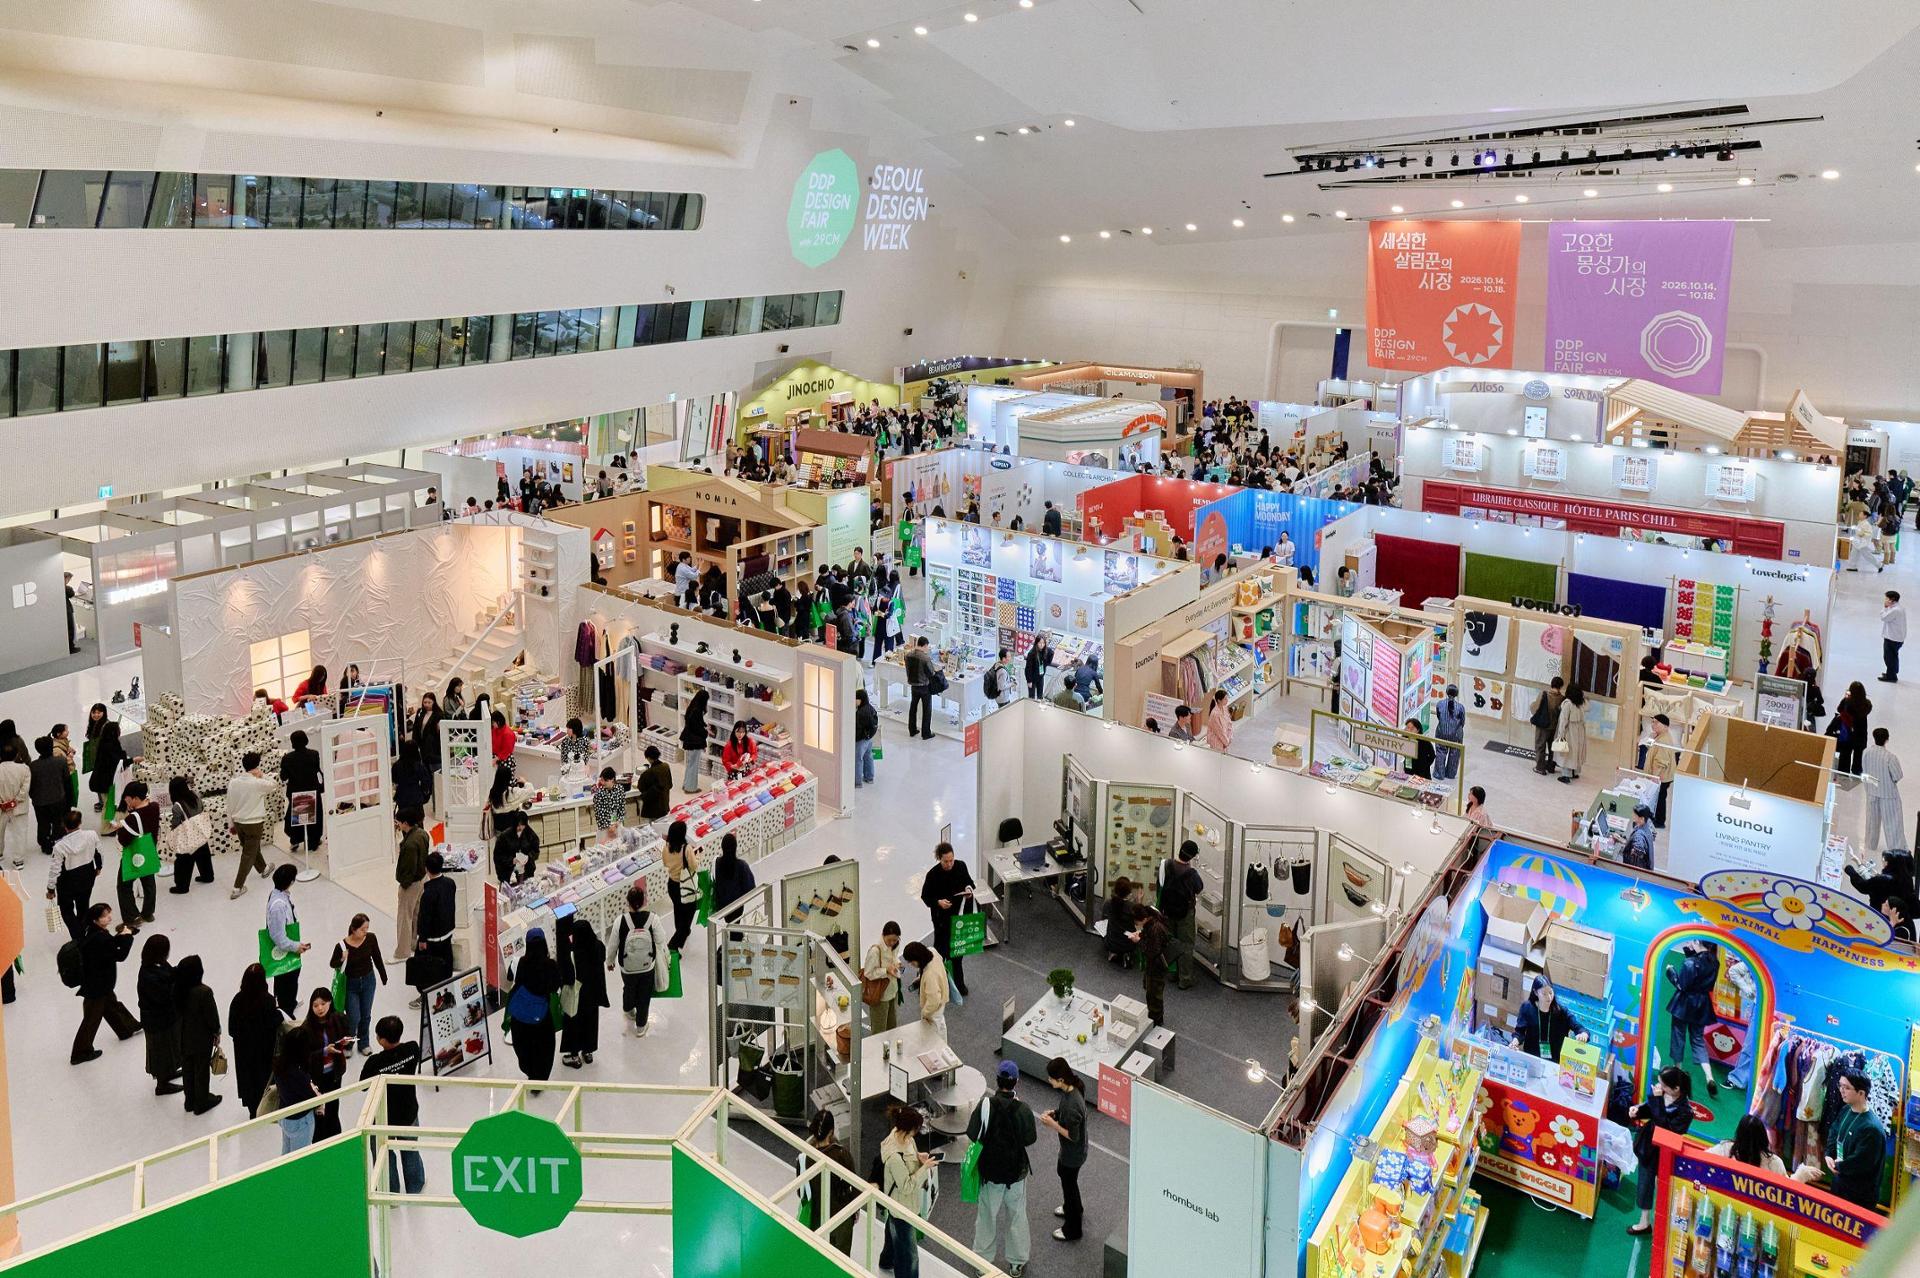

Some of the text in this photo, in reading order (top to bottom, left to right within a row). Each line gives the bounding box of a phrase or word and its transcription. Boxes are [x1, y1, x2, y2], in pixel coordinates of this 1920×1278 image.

[808, 173, 836, 190] DDP
[871, 165, 924, 193] SEOUL
[805, 192, 851, 210] DESIGN
[866, 193, 928, 221] DESIGN
[800, 211, 830, 229] FAIR
[864, 223, 912, 251] WEEK
[1379, 232, 1427, 250] 세심한
[1560, 233, 1615, 253] 고요한
[1394, 252, 1453, 270] 살림꾼의
[1577, 255, 1646, 275] 몽상가의
[1418, 272, 1453, 291] 시장
[1604, 277, 1647, 297] 시장
[1661, 281, 1717, 291] 2026.10.14.
[1689, 291, 1716, 300] 10.18.
[1374, 328, 1396, 338] DDP
[1374, 337, 1415, 350] DESIGN
[1555, 339, 1584, 350] DDP
[1375, 348, 1395, 360] FAIR
[1554, 351, 1607, 363] DESIGN
[1554, 362, 1584, 373] FAIR
[787, 378, 834, 400] JINOCHIO
[696, 491, 737, 506] NOMIA
[1255, 502, 1280, 512] HAPPY
[1255, 511, 1291, 522] MOONDAY
[1472, 492, 1512, 506] LIBRAIRIE
[1513, 497, 1559, 513] CLASSIQUE
[1564, 503, 1602, 518] HÔTEL
[1605, 508, 1640, 522] PARIS
[1642, 513, 1677, 527] CHILL
[1751, 568, 1806, 582] towelogist
[1364, 733, 1406, 751] PANTRY
[1716, 812, 1773, 835] tounou
[1715, 831, 1740, 844] LIVING
[1741, 838, 1772, 851] PANTRY
[1720, 913, 1885, 969] MAXIMAL HAPPINESS
[463, 1155, 570, 1195] EXIT
[1519, 1170, 1567, 1196] WIGGLE
[1163, 1188, 1220, 1223] rhombus lab
[1731, 1173, 1865, 1240] WIGGLE WIGGLE
